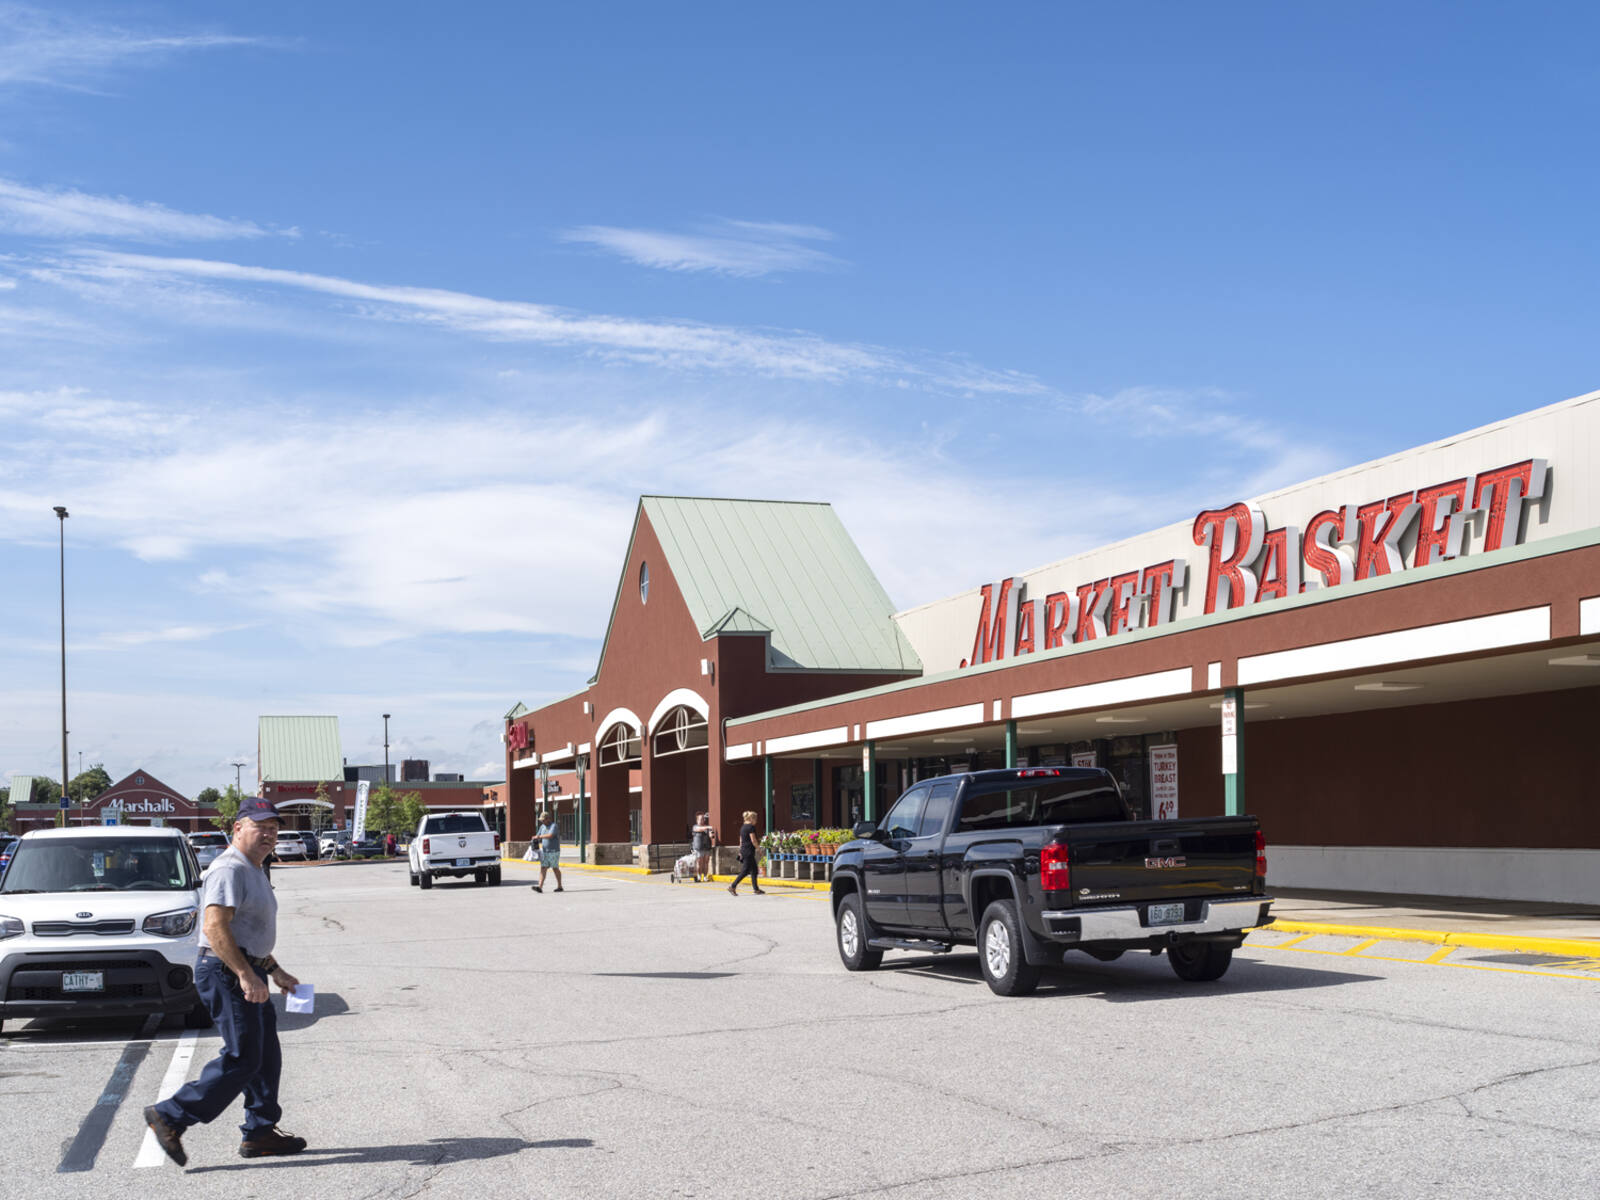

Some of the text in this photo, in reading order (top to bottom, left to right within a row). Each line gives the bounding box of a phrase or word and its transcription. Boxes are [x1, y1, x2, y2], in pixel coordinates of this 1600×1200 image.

[960, 458, 1547, 669] MARKET BASKET
[1153, 761, 1176, 772] TURKEY
[1153, 773, 1176, 784] BREAST
[108, 798, 176, 812] Marshalls
[1144, 856, 1186, 869] GMC
